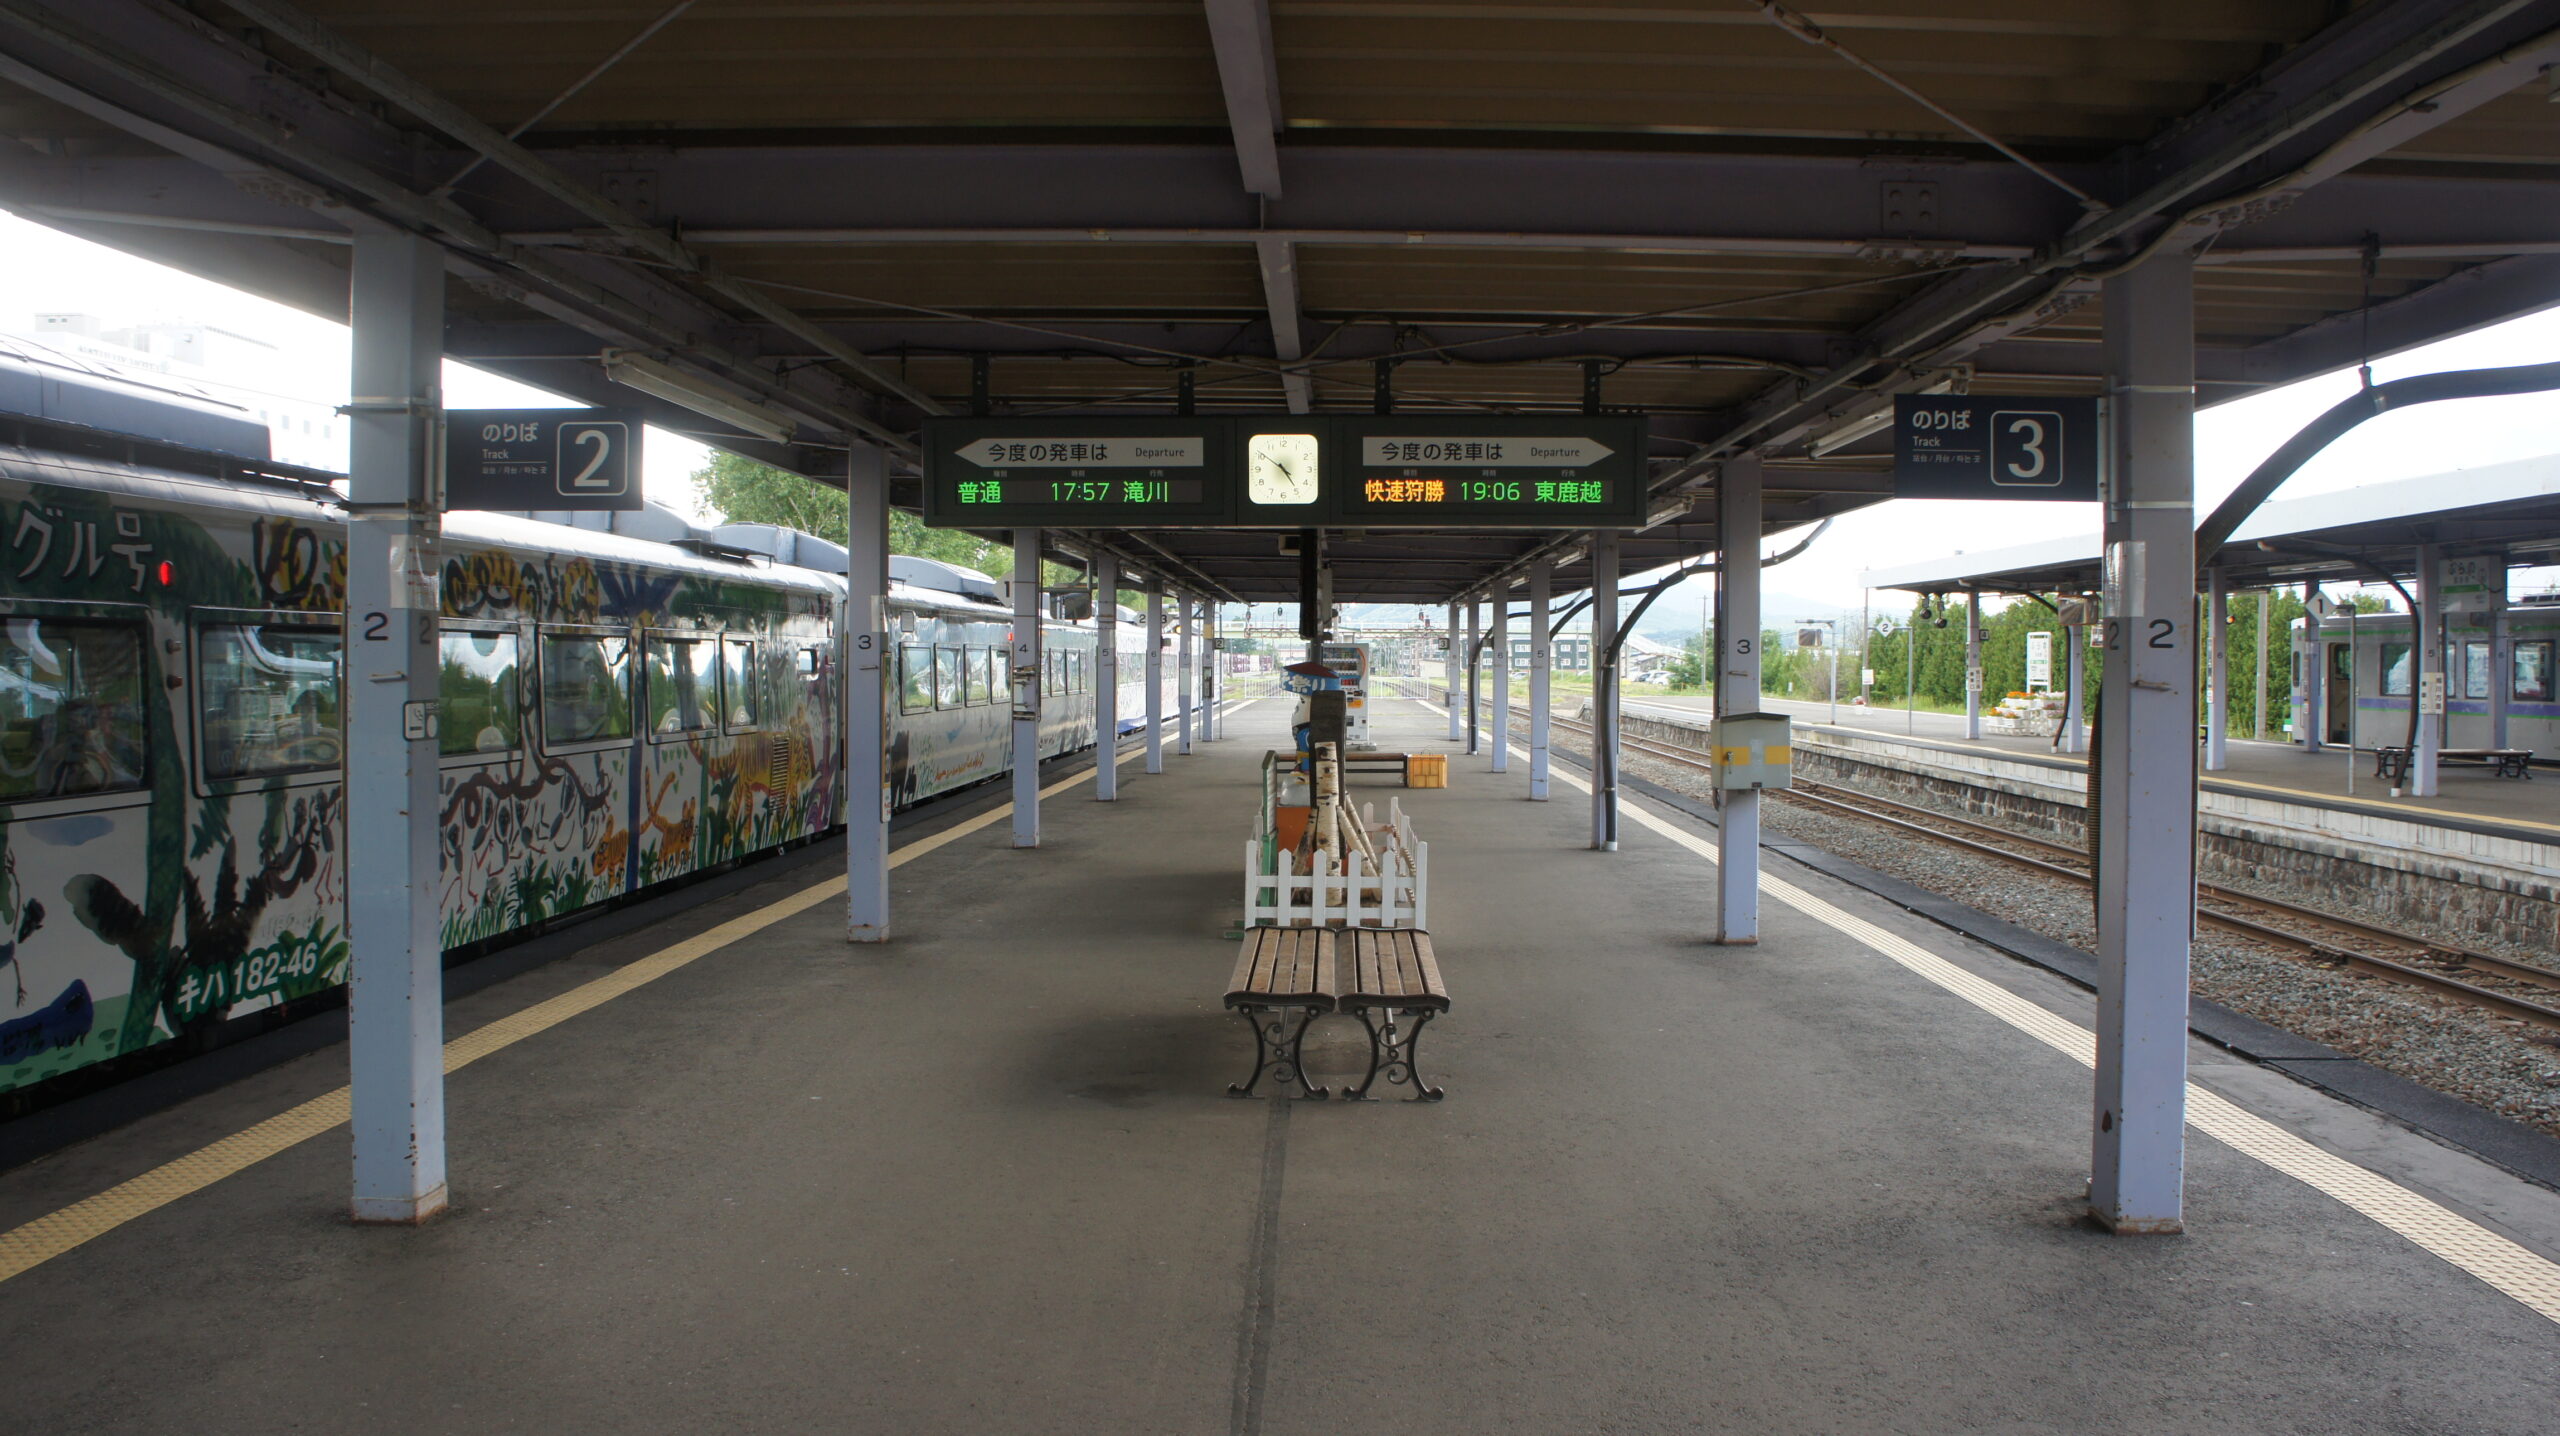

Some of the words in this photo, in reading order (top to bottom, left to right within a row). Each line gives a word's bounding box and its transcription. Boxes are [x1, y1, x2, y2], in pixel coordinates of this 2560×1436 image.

[1912, 409, 1971, 431] のりば
[482, 422, 539, 443] のりば
[1912, 435, 1941, 447] Track
[482, 448, 509, 460] Track
[987, 443, 1108, 462] 今度の発車は
[1135, 447, 1185, 459] Departure
[1381, 442, 1503, 462] 今度の発車は
[1530, 447, 1580, 459] Departure
[2007, 418, 2045, 479] 3
[574, 429, 610, 488] 2
[957, 480, 1002, 504] 普通
[1050, 481, 1110, 502] 17:57
[1123, 480, 1169, 504] 滝川
[1364, 479, 1445, 503] 快速狩勝
[1460, 481, 1520, 502] 19:06
[1534, 480, 1603, 504] 東鹿越
[12, 507, 153, 593] グル号
[1004, 581, 1010, 598] 1
[2317, 598, 2323, 614] 1
[364, 611, 389, 641] 2
[1139, 614, 1147, 624] 2
[1161, 614, 1168, 624] 3
[1882, 623, 1889, 632] 2
[418, 616, 432, 645] 2
[2108, 621, 2119, 650] 2
[2148, 618, 2174, 649] 2
[857, 634, 872, 650] 3
[1018, 644, 1028, 653] 4
[1216, 639, 1222, 647] 2
[1736, 639, 1751, 655] 3
[1102, 648, 1109, 657] 5
[1537, 650, 1544, 658] 5
[177, 968, 226, 1014] キハ
[233, 941, 319, 996] 182-46
